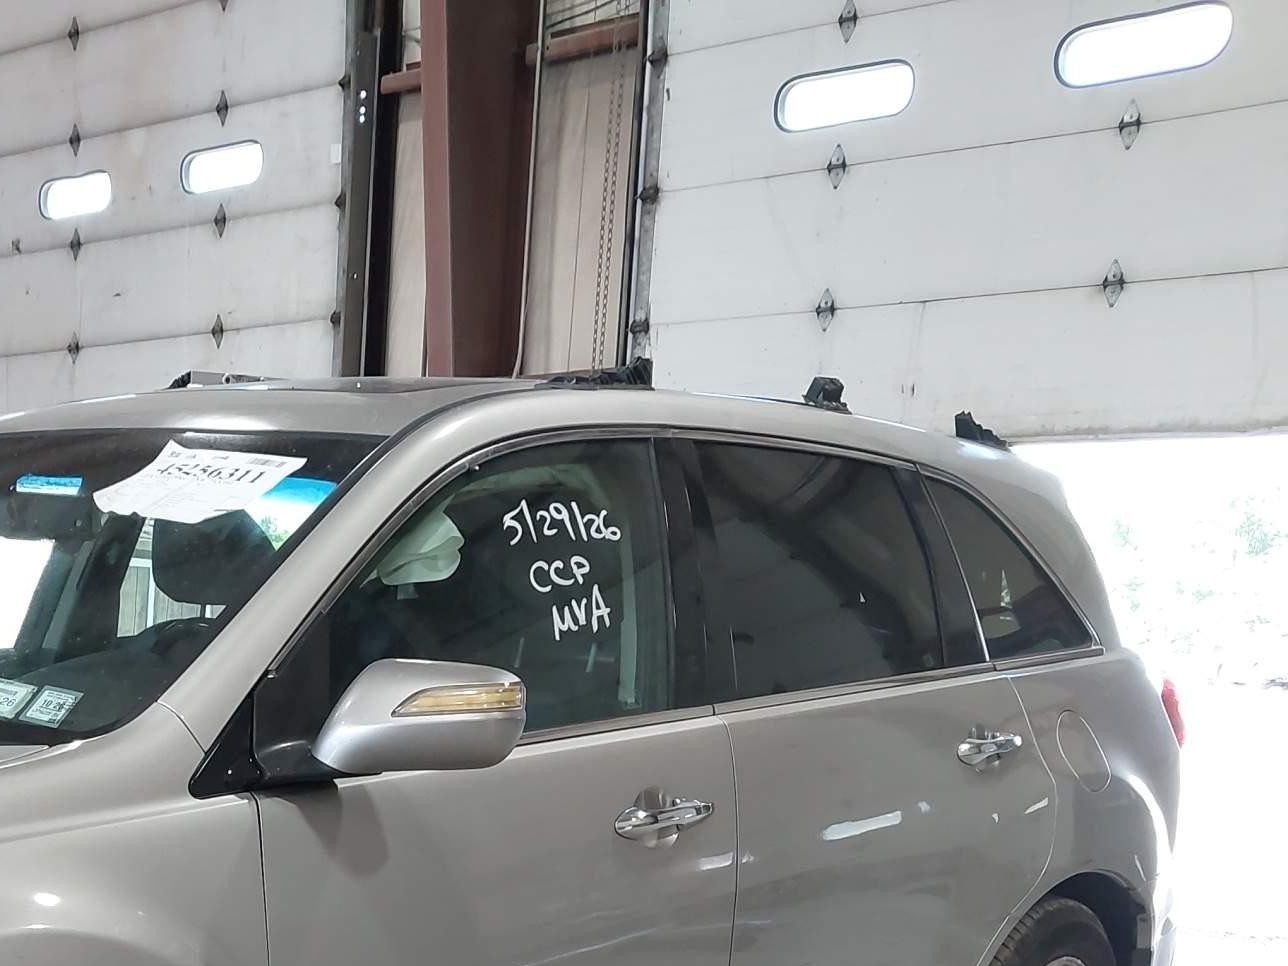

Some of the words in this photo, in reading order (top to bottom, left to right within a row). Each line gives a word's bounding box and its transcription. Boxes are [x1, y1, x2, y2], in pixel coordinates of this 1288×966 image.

[157, 463, 265, 483] 45256311
[503, 499, 621, 546] 5/29/26
[529, 555, 590, 593] CCP
[552, 583, 611, 642] MVA
[0, 697, 17, 707] 26
